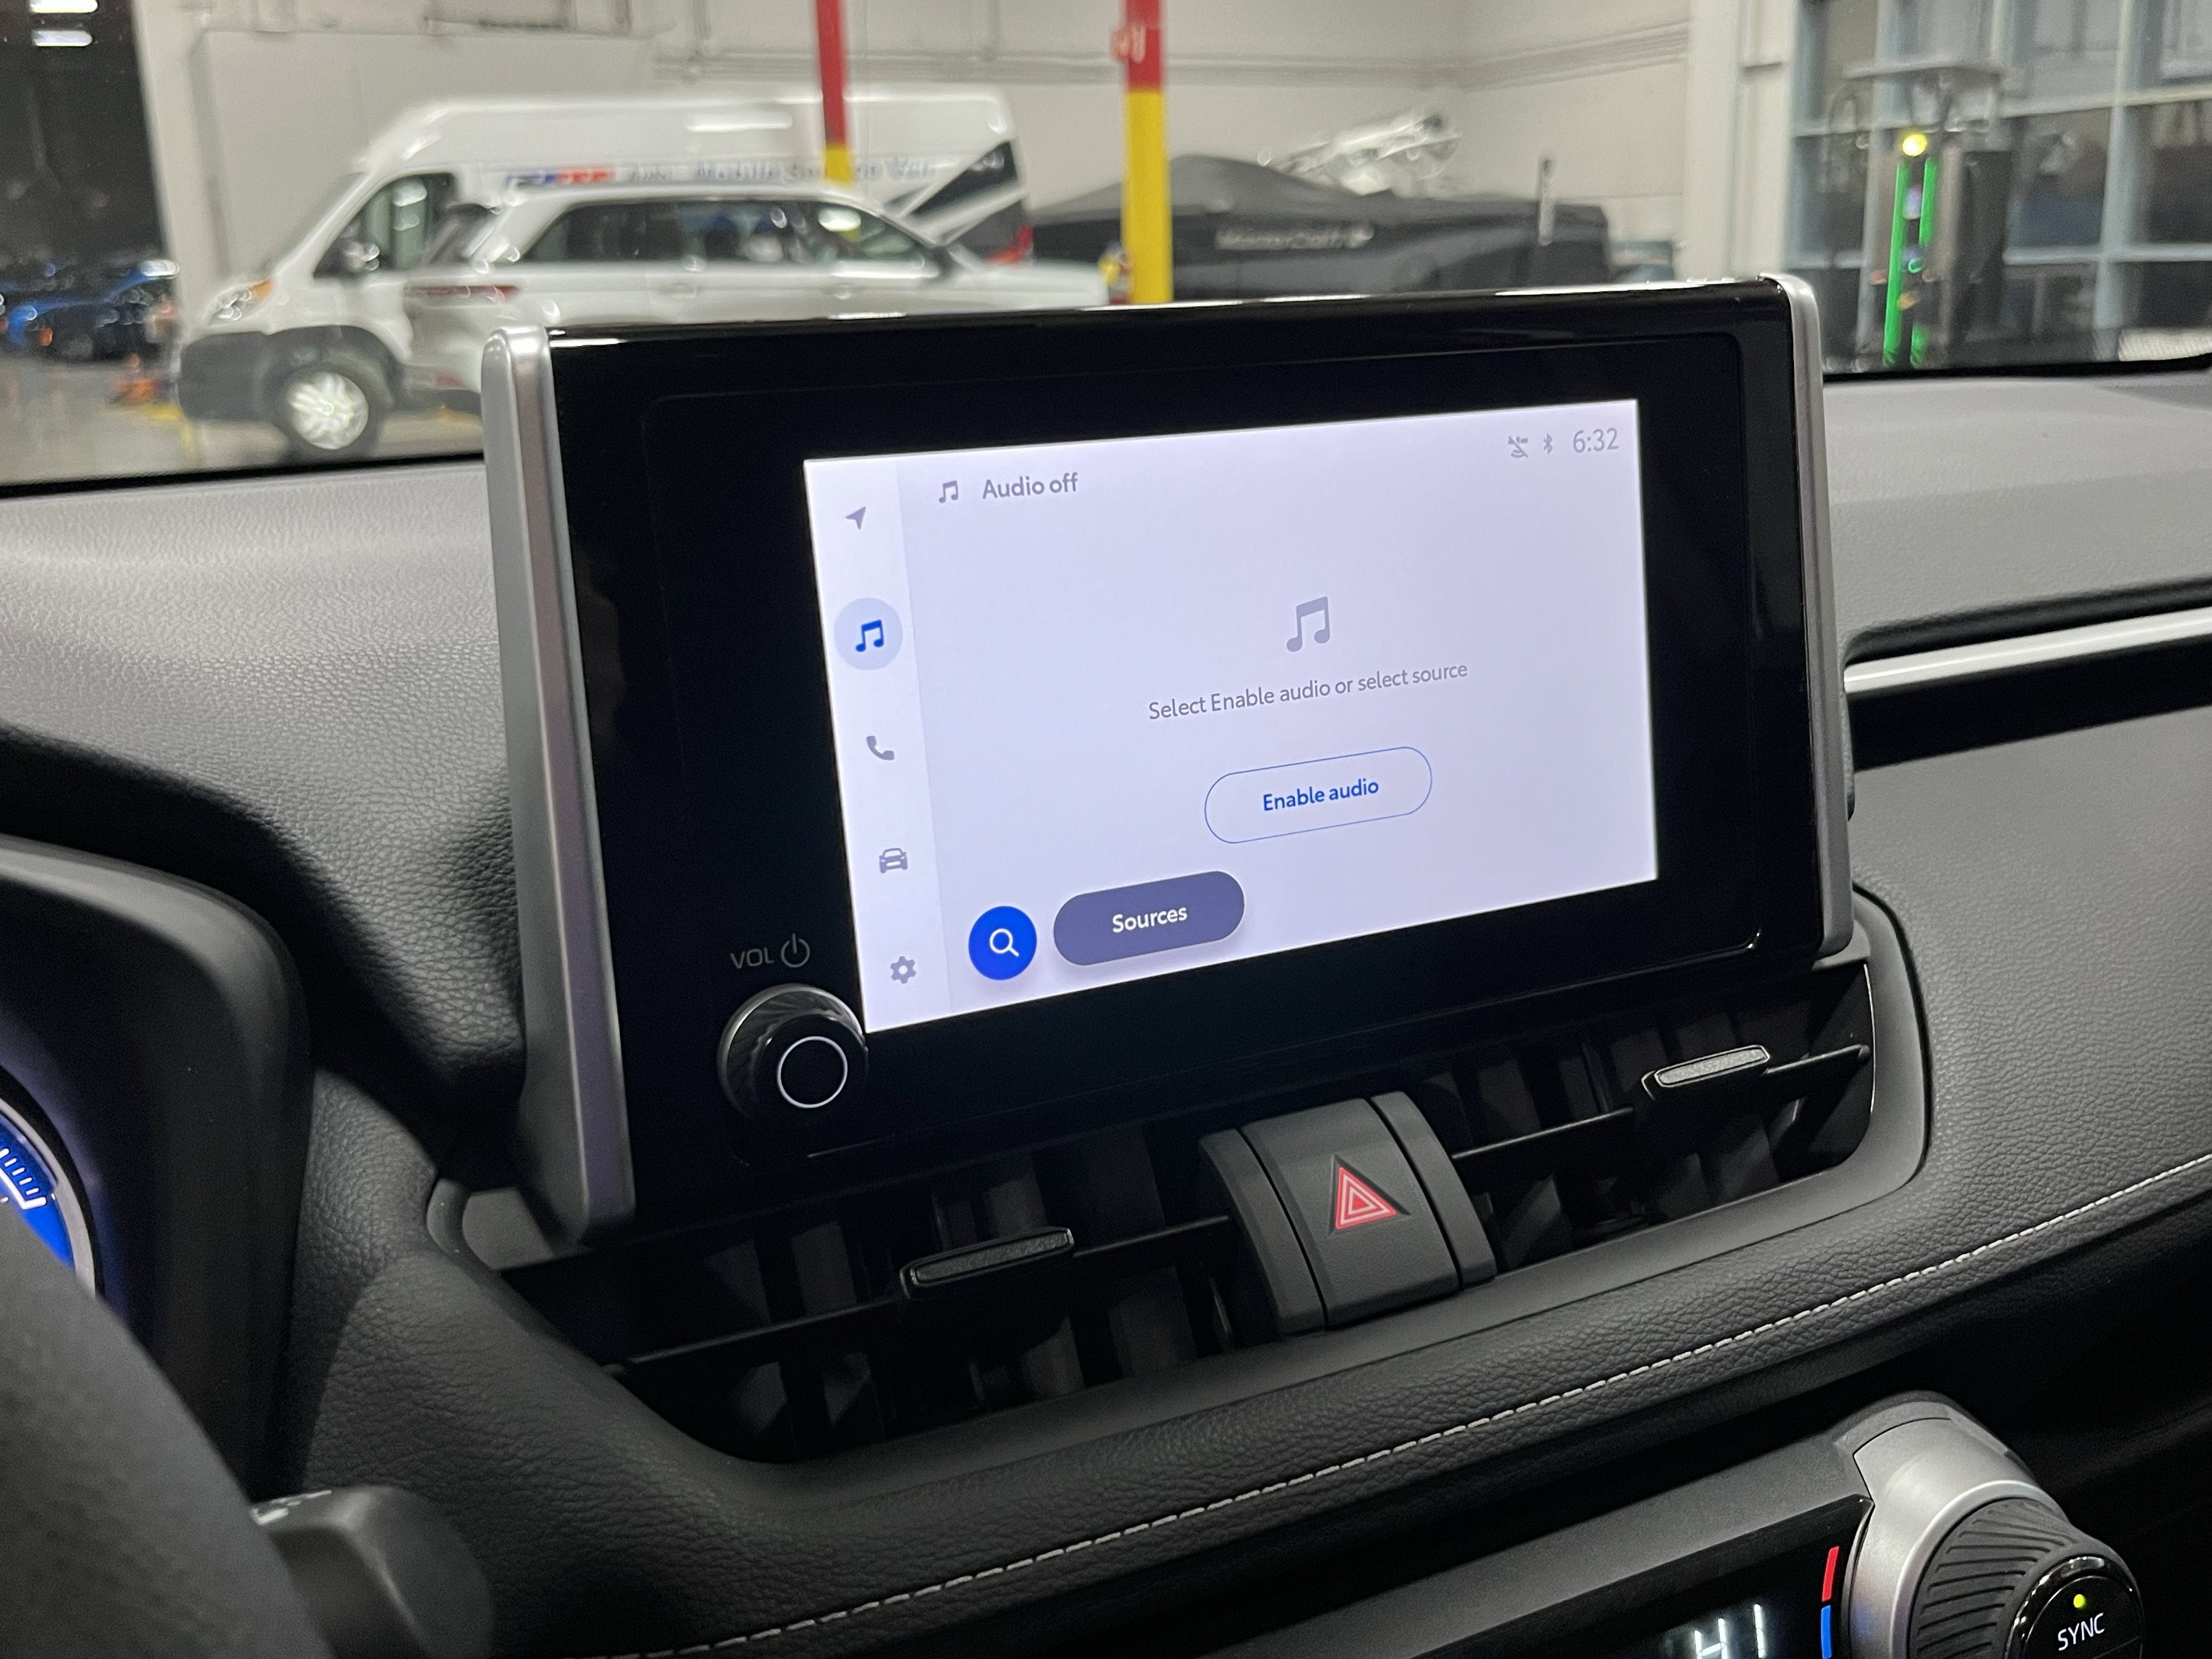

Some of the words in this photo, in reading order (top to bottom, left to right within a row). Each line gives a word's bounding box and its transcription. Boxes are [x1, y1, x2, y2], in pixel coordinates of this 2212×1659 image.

[1573, 427, 1619, 453] 6:32
[982, 476, 1045, 500] Audio
[1049, 471, 1079, 493] off
[1148, 696, 1207, 720] Select
[1210, 686, 1275, 712] Enable
[1279, 680, 1331, 702] audio
[1334, 680, 1352, 694] or
[1357, 669, 1409, 691] select
[1412, 663, 1468, 684] source
[1263, 786, 1325, 811] Enable
[1329, 778, 1379, 801] audio
[1111, 906, 1188, 933] Sources
[730, 946, 775, 969] VOL
[2057, 1612, 2106, 1651] SYNC
